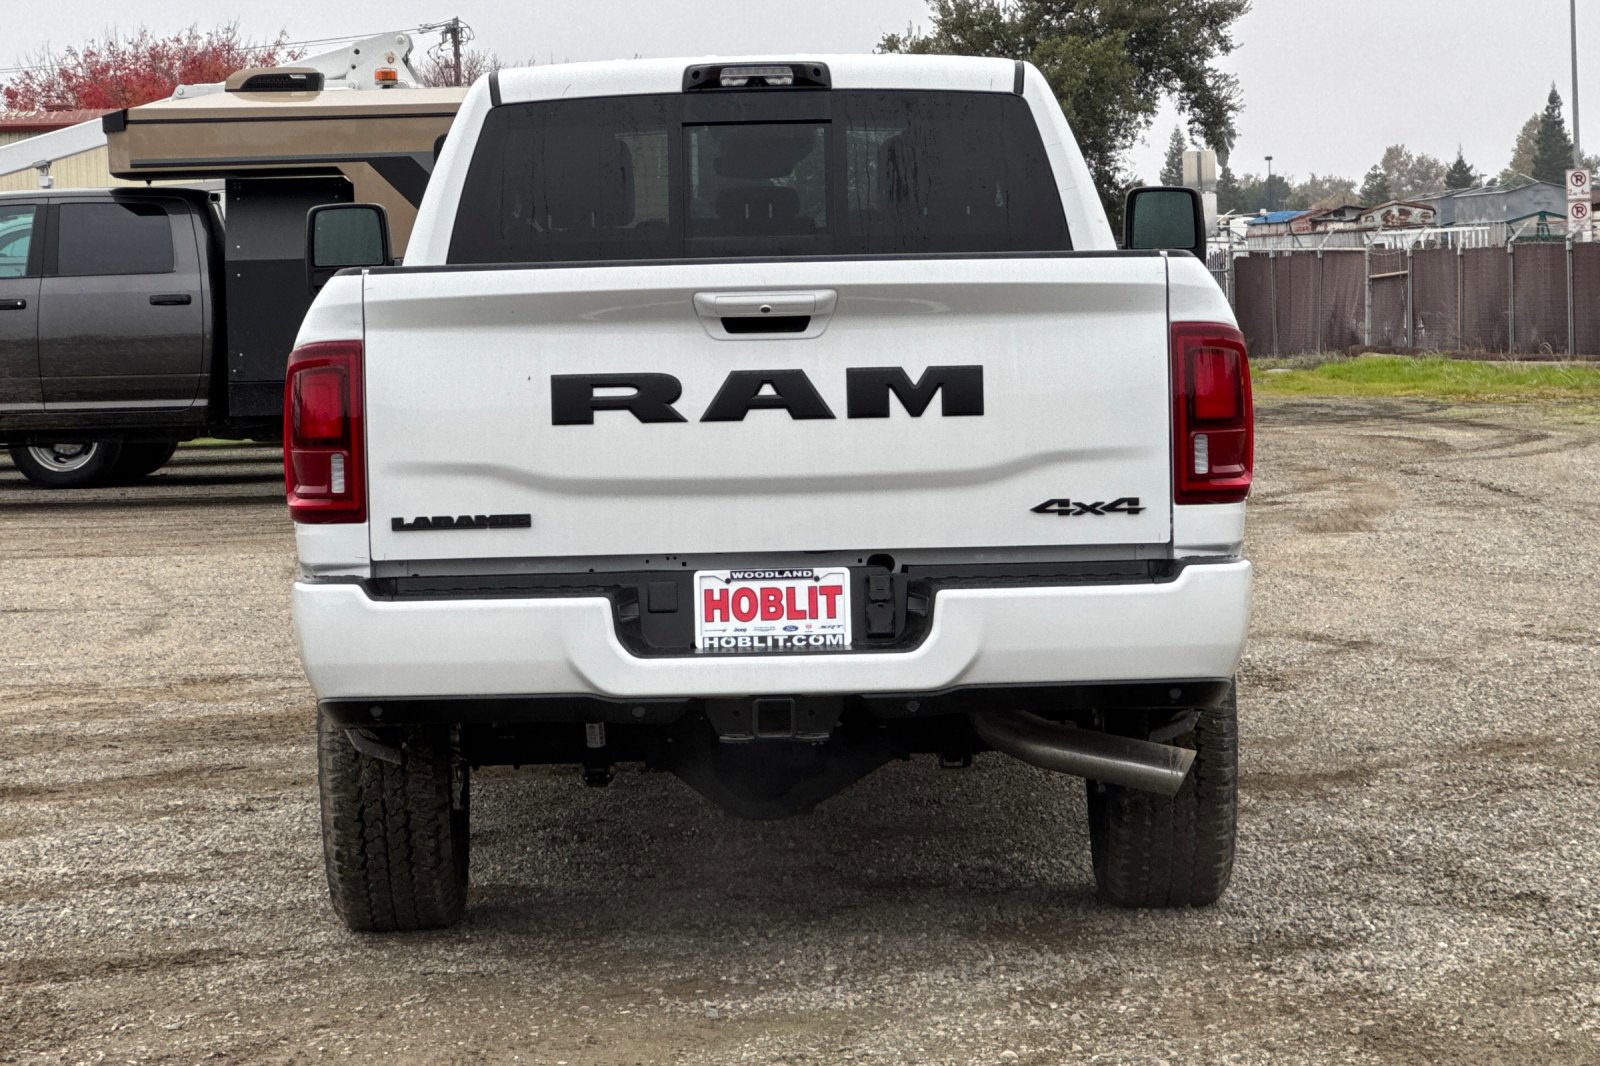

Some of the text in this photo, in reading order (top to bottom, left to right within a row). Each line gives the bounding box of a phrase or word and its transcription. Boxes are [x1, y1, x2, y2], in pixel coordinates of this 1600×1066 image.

[550, 365, 984, 426] RAM
[1030, 497, 1147, 516] 4x4
[391, 513, 532, 532] LARAMIE
[731, 570, 813, 579] WOODLAND
[704, 585, 843, 623] HOBLIT
[704, 634, 843, 647] HOBLIT.COM
